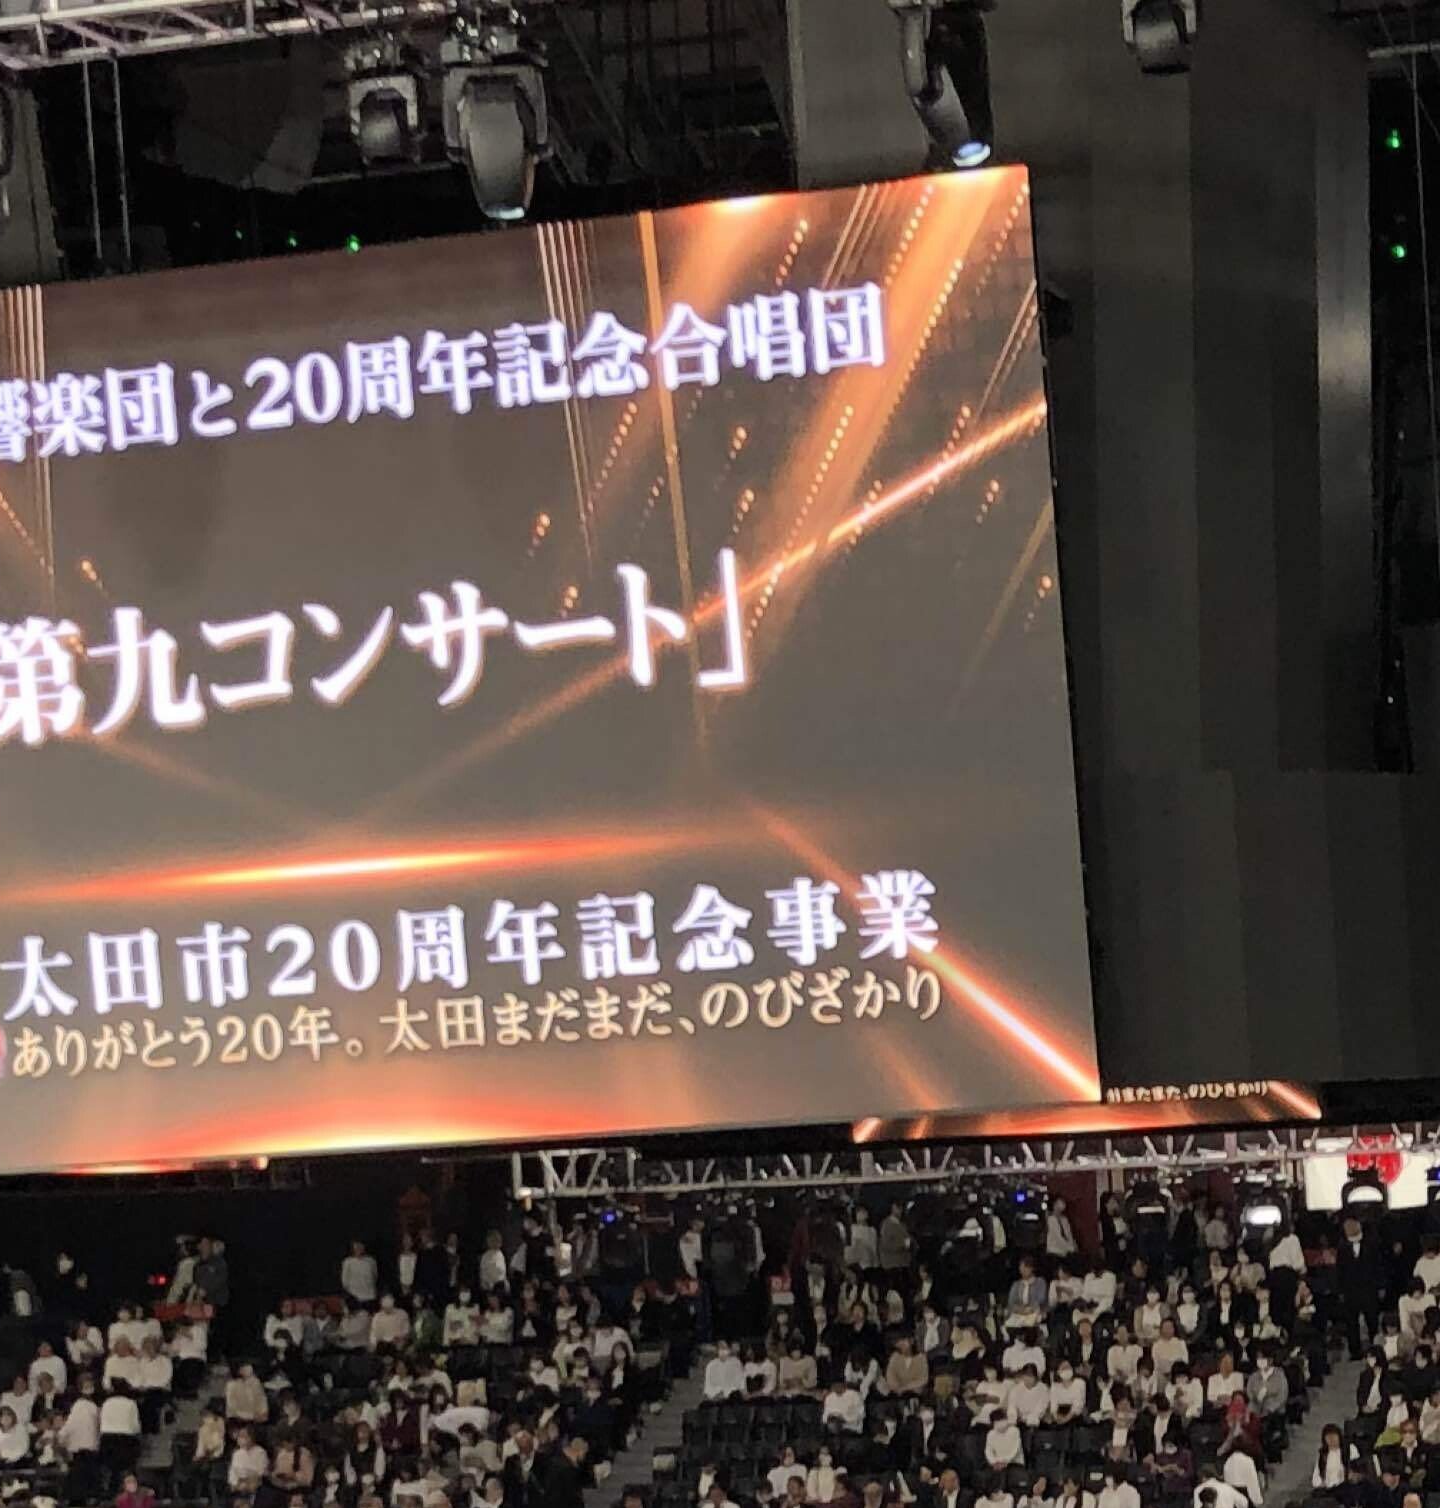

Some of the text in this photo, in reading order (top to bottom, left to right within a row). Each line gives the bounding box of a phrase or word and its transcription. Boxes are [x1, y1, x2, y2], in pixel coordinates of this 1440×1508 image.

[0, 870, 939, 1021] 太田市20周年記念事業
